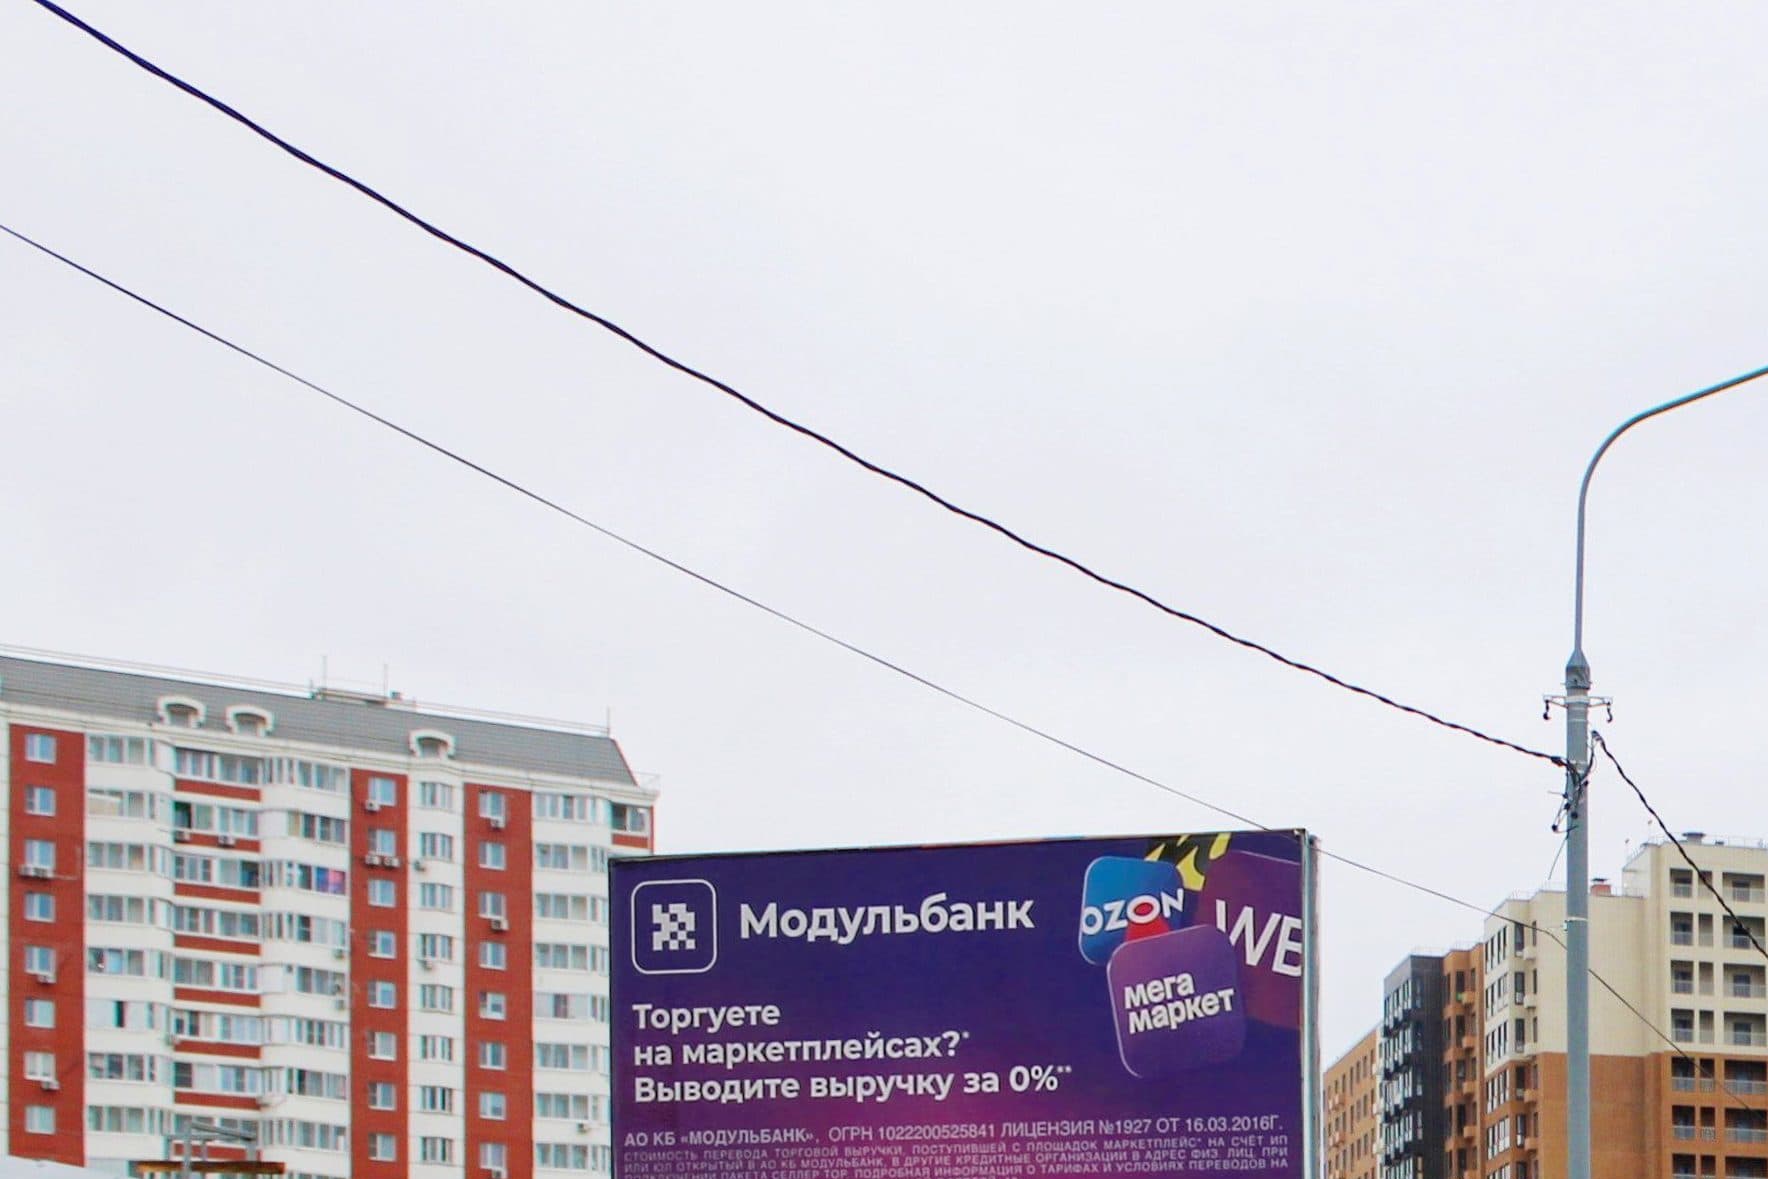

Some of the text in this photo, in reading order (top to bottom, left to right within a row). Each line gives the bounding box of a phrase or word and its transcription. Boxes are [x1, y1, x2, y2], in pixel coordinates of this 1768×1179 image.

[739, 892, 1036, 946] Модульбанк
[1080, 888, 1185, 936] OZON
[632, 1002, 782, 1035] Торгуете
[633, 1044, 673, 1067] на
[634, 1075, 801, 1105] Выводите
[809, 1071, 955, 1101] выручку
[962, 1072, 1000, 1093] за
[623, 1131, 649, 1147] АО
[652, 1130, 676, 1147] КБ
[827, 1126, 873, 1143] ОГРН
[877, 1123, 995, 1141] 1022200525841
[1000, 1120, 1095, 1138] ЛИЦЕНЗИЯ
[1097, 1118, 1153, 1136] №1927
[1155, 1118, 1181, 1134] ОТ
[702, 1148, 768, 1161] ПЕРЕВОДА
[774, 1146, 839, 1159] ТОРГОВОЙ
[911, 1142, 1007, 1156] ПОСТУПИВШЕЙ
[1025, 1140, 1097, 1152] ПЛОЩАДОК
[1206, 1137, 1225, 1148] НА
[1269, 1135, 1289, 1147] ИП
[759, 1159, 777, 1170] АО
[903, 1155, 951, 1167] ДРУГИЕ
[955, 1153, 1031, 1166] КРЕДИТНЫЕ
[1034, 1150, 1128, 1163] ОРГАНИЗАЦИИ
[1130, 1150, 1140, 1161] В
[1143, 1149, 1186, 1161] АДРЕС
[1261, 1146, 1289, 1158] ПРИ
[853, 1166, 931, 1179] ПОДРОБНАЯ
[933, 1164, 1023, 1177] ИНФОРМАЦИЯ
[1039, 1162, 1099, 1174] ТАРИФАХ
[1101, 1161, 1113, 1173] И
[1115, 1160, 1185, 1172] УСЛОВИЯХ
[1187, 1158, 1268, 1171] ПЕРЕВОДОВ
[1269, 1157, 1289, 1169] НА
